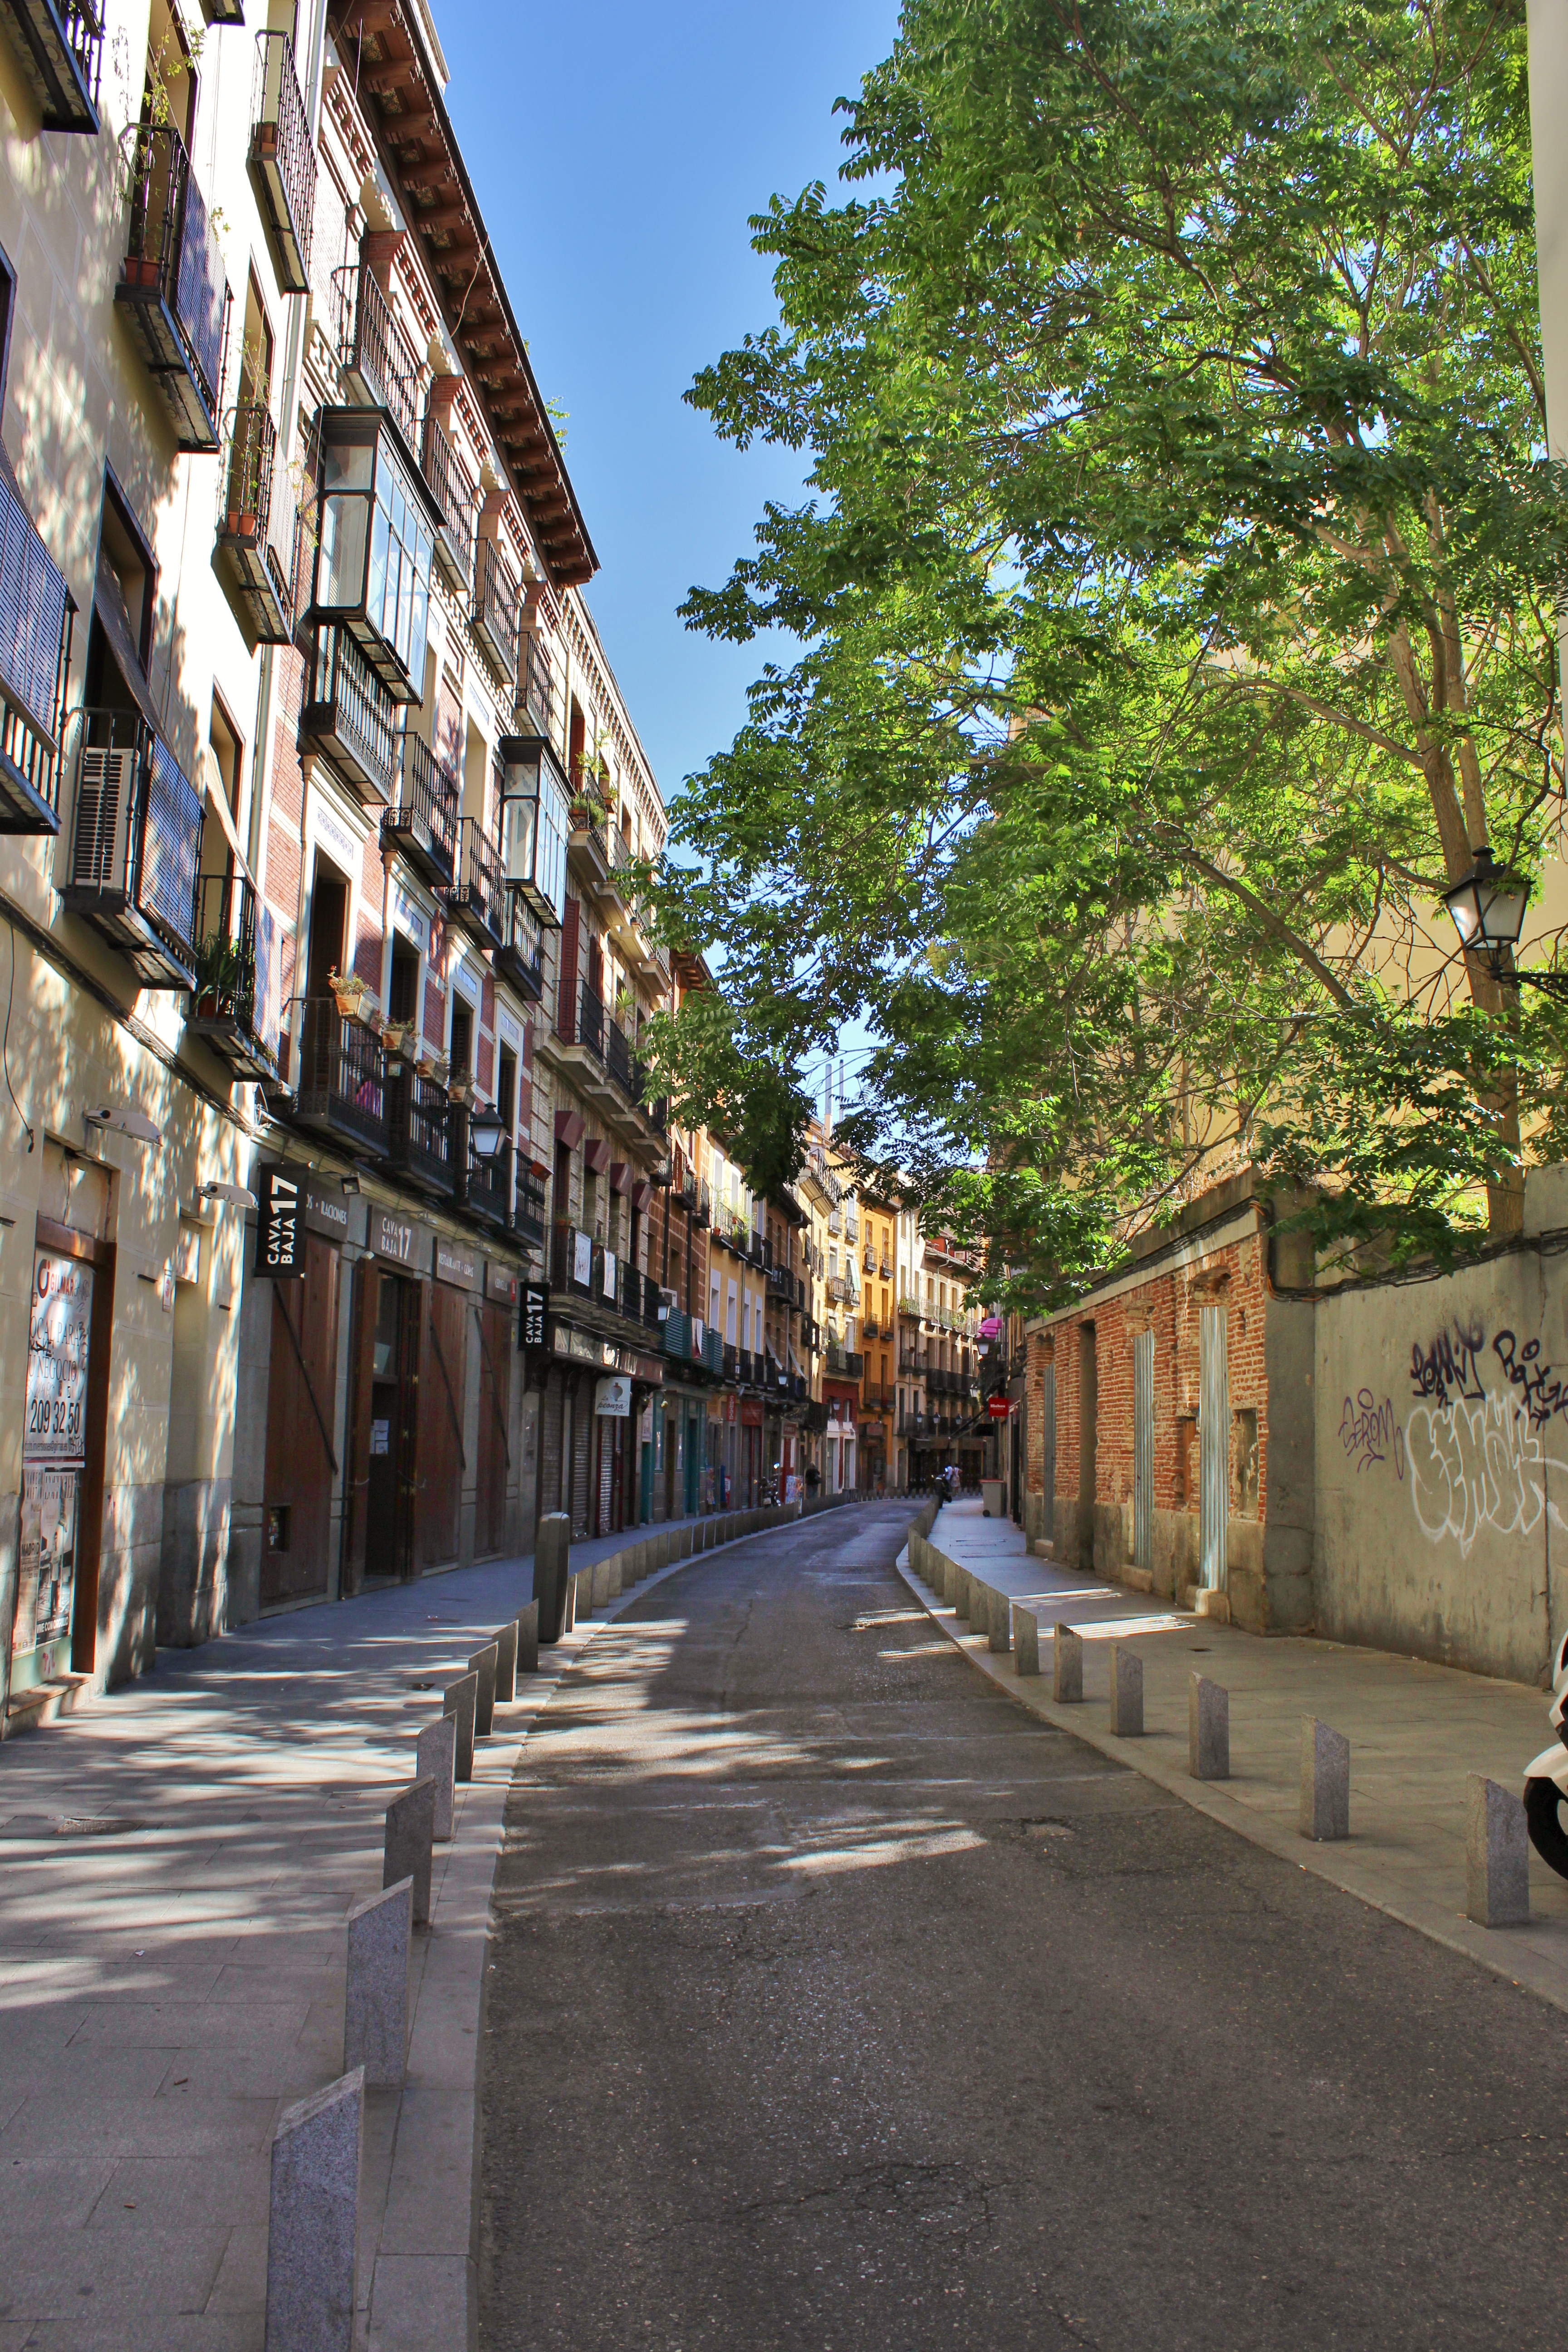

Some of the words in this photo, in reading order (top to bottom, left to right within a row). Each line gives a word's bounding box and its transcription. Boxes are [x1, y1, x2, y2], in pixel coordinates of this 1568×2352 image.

[270, 1174, 298, 1214] 17
[320, 1200, 347, 1225] RACIONES
[382, 1217, 398, 1237] CAVA
[267, 1218, 282, 1264] CAVA
[280, 1218, 295, 1264] BAJA
[381, 1235, 397, 1256] BAJA
[398, 1225, 412, 1260] 17
[50, 1273, 74, 1297] GILMAR
[526, 1289, 543, 1313] 17
[57, 1321, 80, 1347] PARA
[526, 1315, 534, 1343] CAVA
[534, 1315, 543, 1343] BAJA
[37, 1356, 77, 1382] NEGOCIO
[30, 1399, 51, 1434] 209
[53, 1401, 66, 1434] 32
[68, 1402, 80, 1434] 50
[596, 1401, 624, 1412] peonza
[21, 1542, 40, 1557] MADRID
[36, 1623, 44, 1634] VIVE
[44, 1620, 53, 1632] CON
[53, 1616, 69, 1630] ORGULLO
